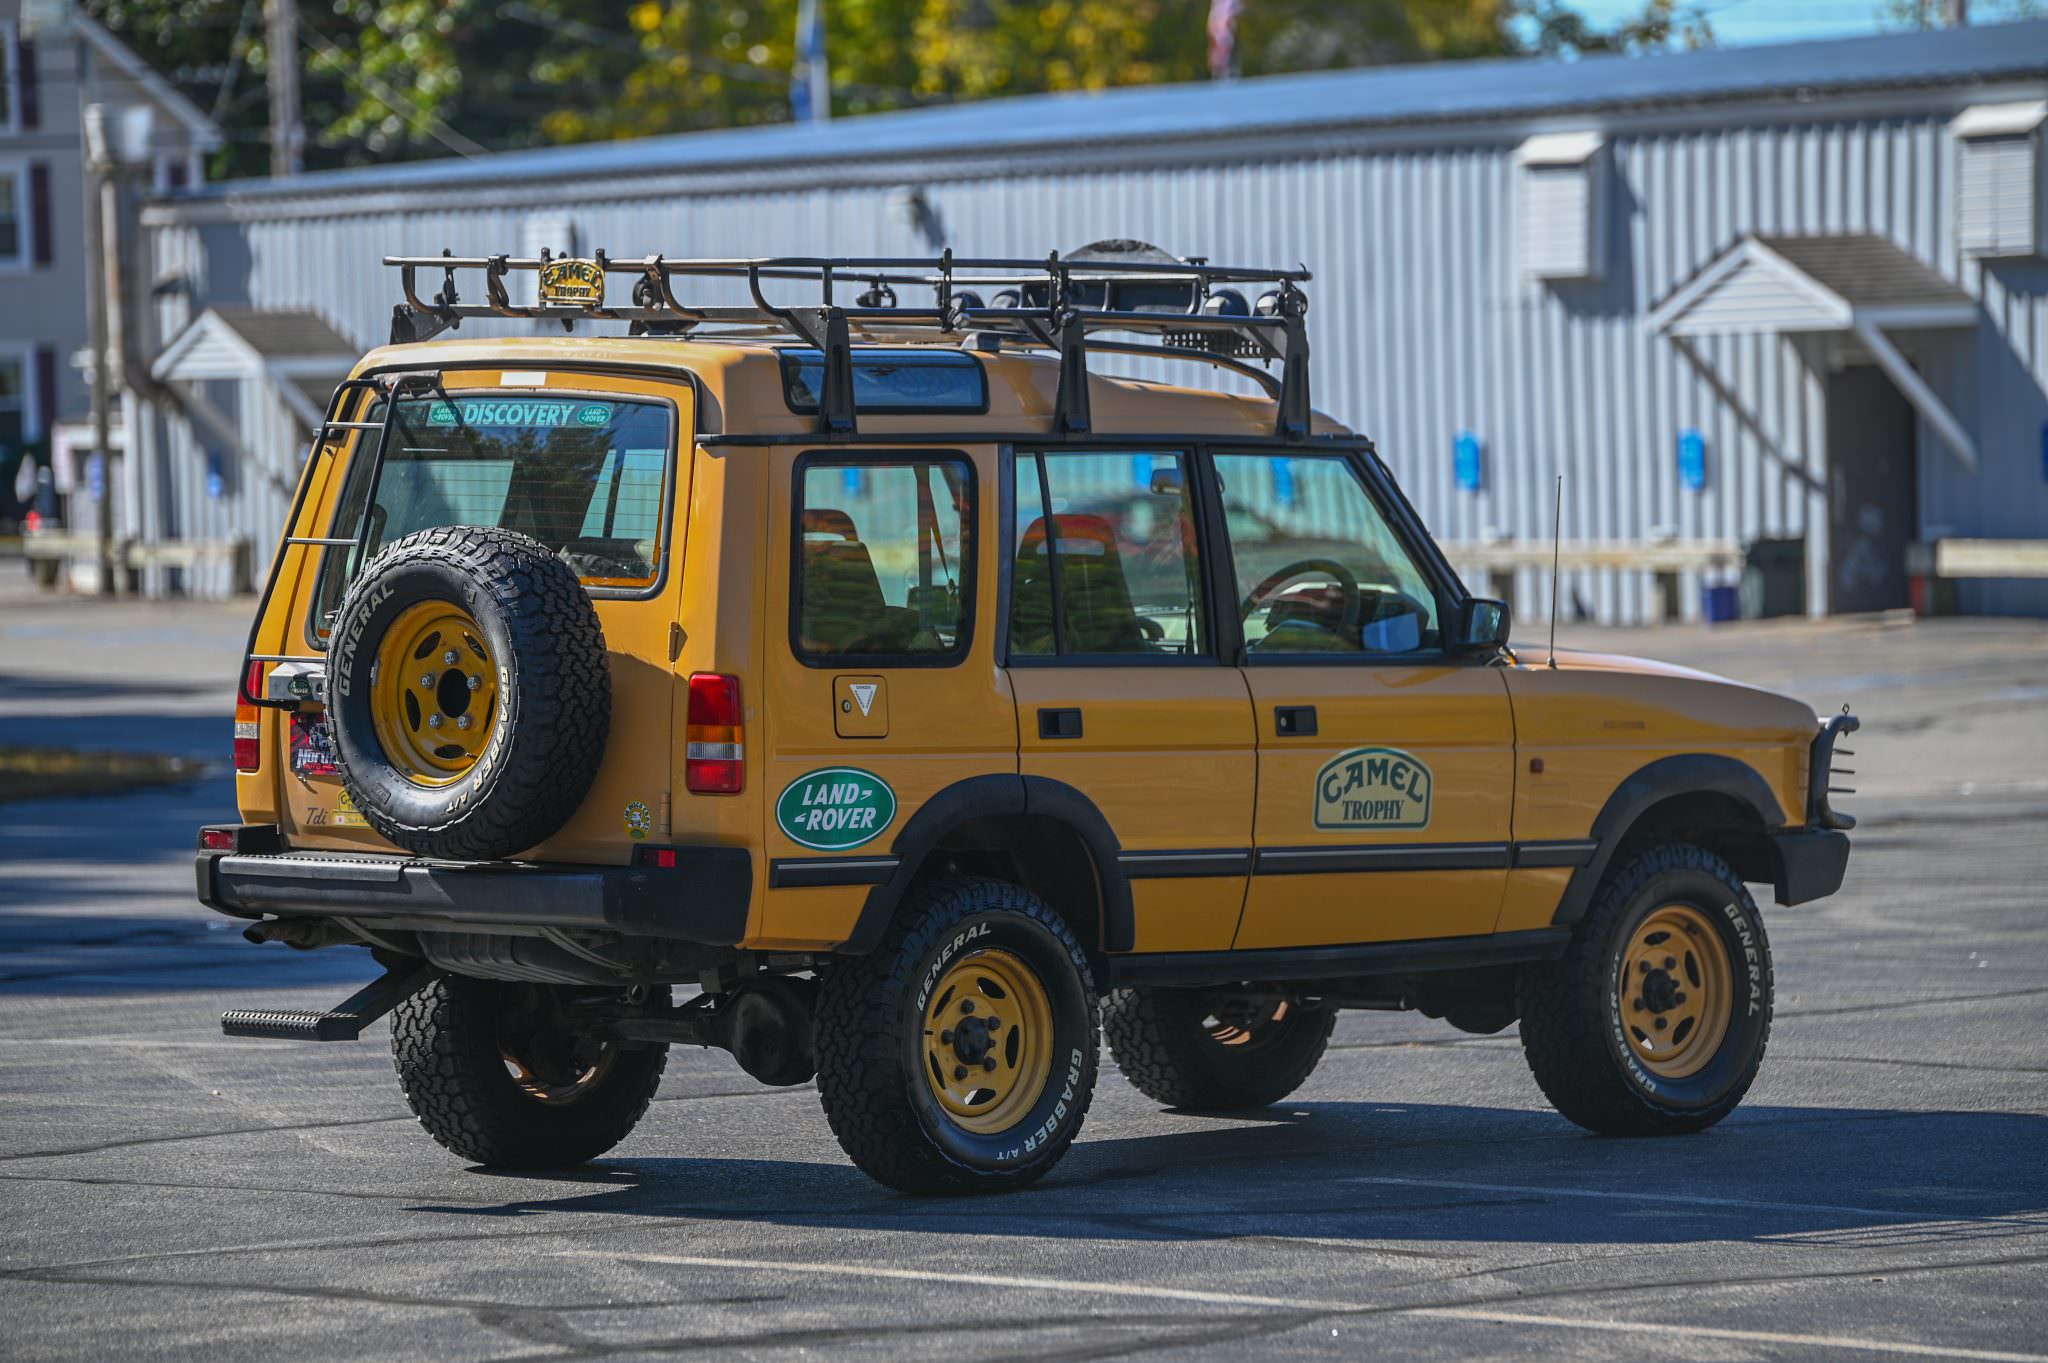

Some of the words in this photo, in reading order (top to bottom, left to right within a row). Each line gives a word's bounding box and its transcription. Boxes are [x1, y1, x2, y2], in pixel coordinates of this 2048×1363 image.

[543, 263, 602, 289] CAMEL
[555, 286, 591, 297] TROPHY
[463, 404, 576, 425] DISCOVERY
[338, 581, 395, 697] GENERAL
[473, 666, 511, 792] GRABBER
[1322, 758, 1424, 804] CAMEL
[802, 783, 859, 806] LAND
[306, 807, 329, 825] Tdi
[806, 807, 876, 831] ROVER
[1342, 800, 1405, 821] TROPHY
[916, 922, 991, 1011] GENERAL
[1723, 903, 1761, 1017] GENERAL
[1024, 1048, 1083, 1153] GRABBER
[996, 1149, 1019, 1161] A/T
